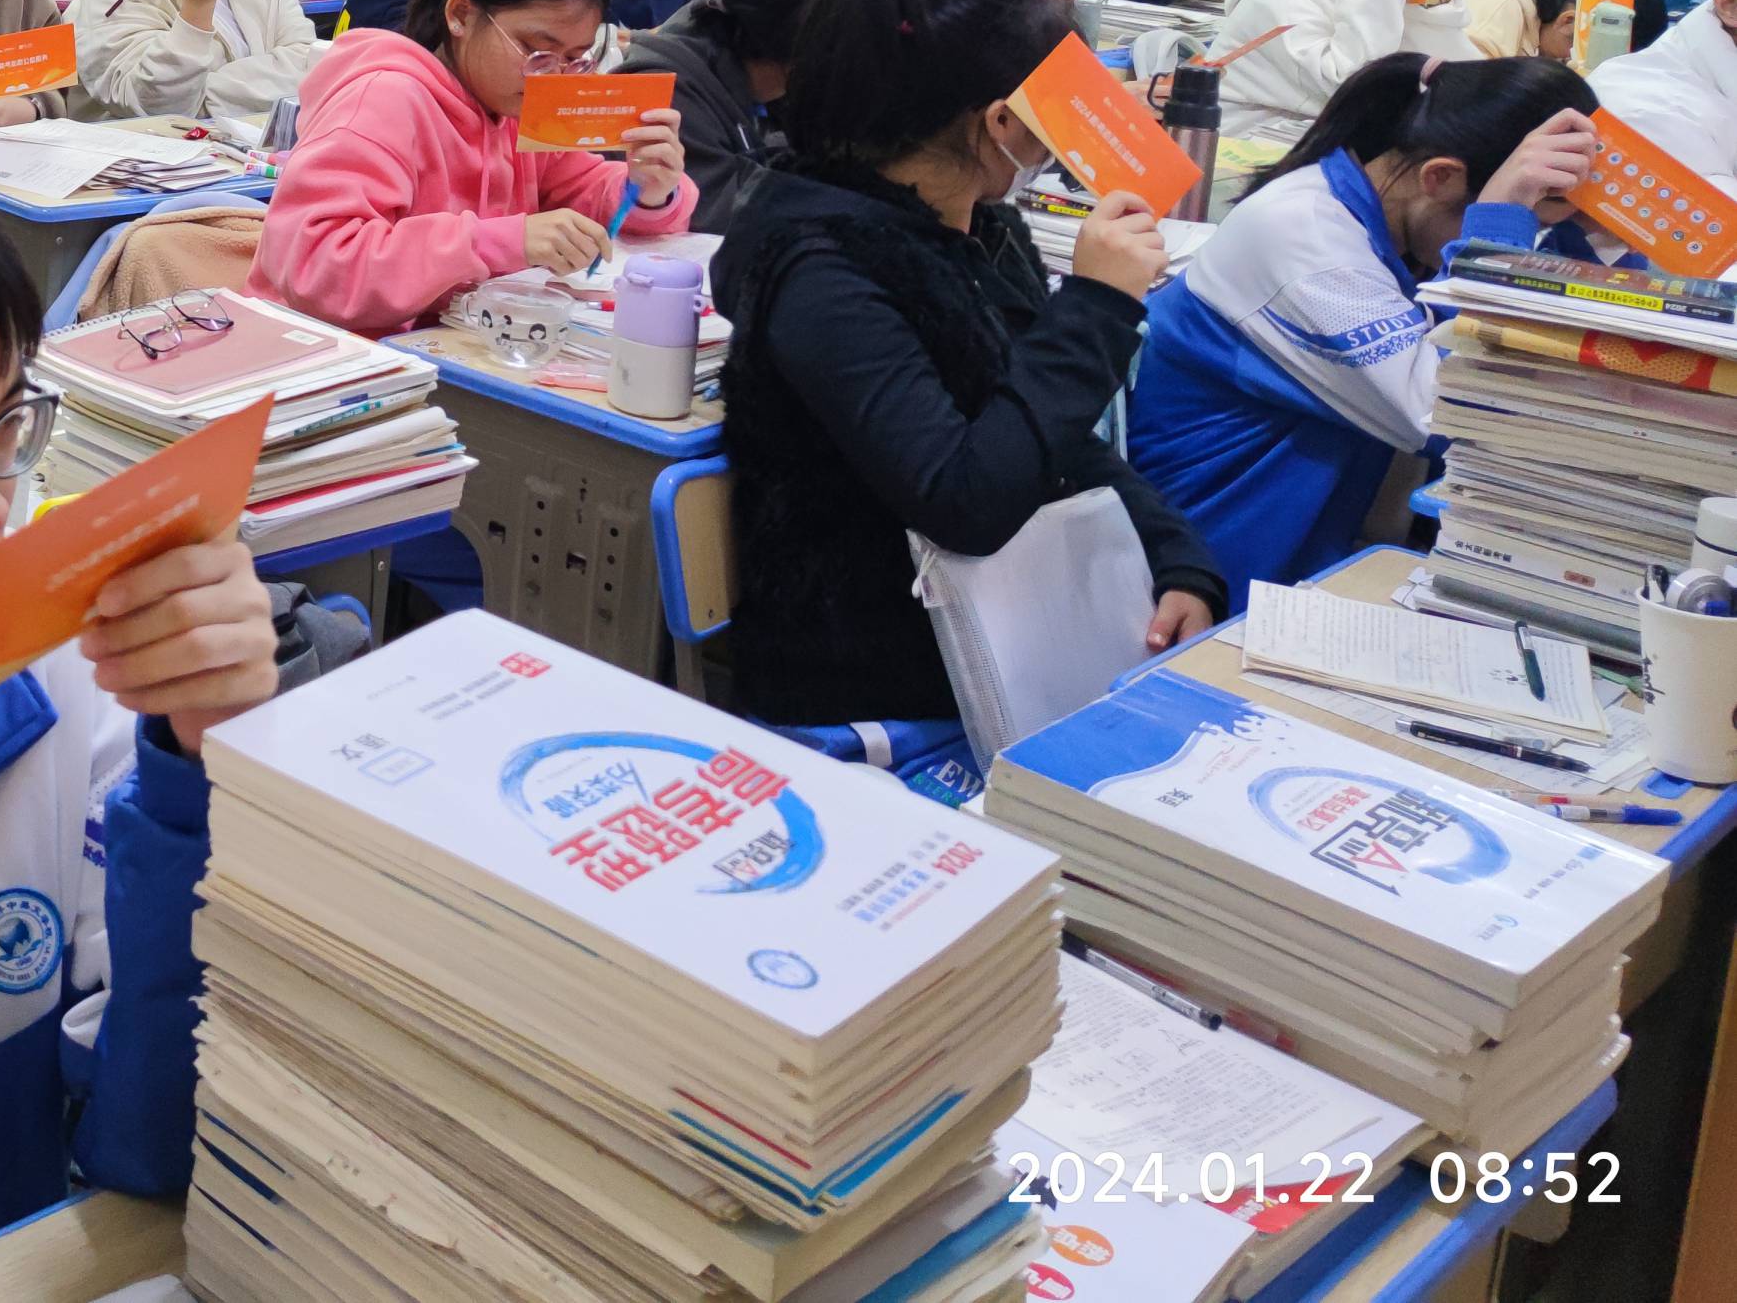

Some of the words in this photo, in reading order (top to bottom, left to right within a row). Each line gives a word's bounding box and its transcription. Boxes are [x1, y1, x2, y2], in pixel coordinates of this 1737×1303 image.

[1346, 313, 1415, 349] STUDY
[547, 743, 793, 894] 高考题型
[930, 841, 986, 881] 2024
